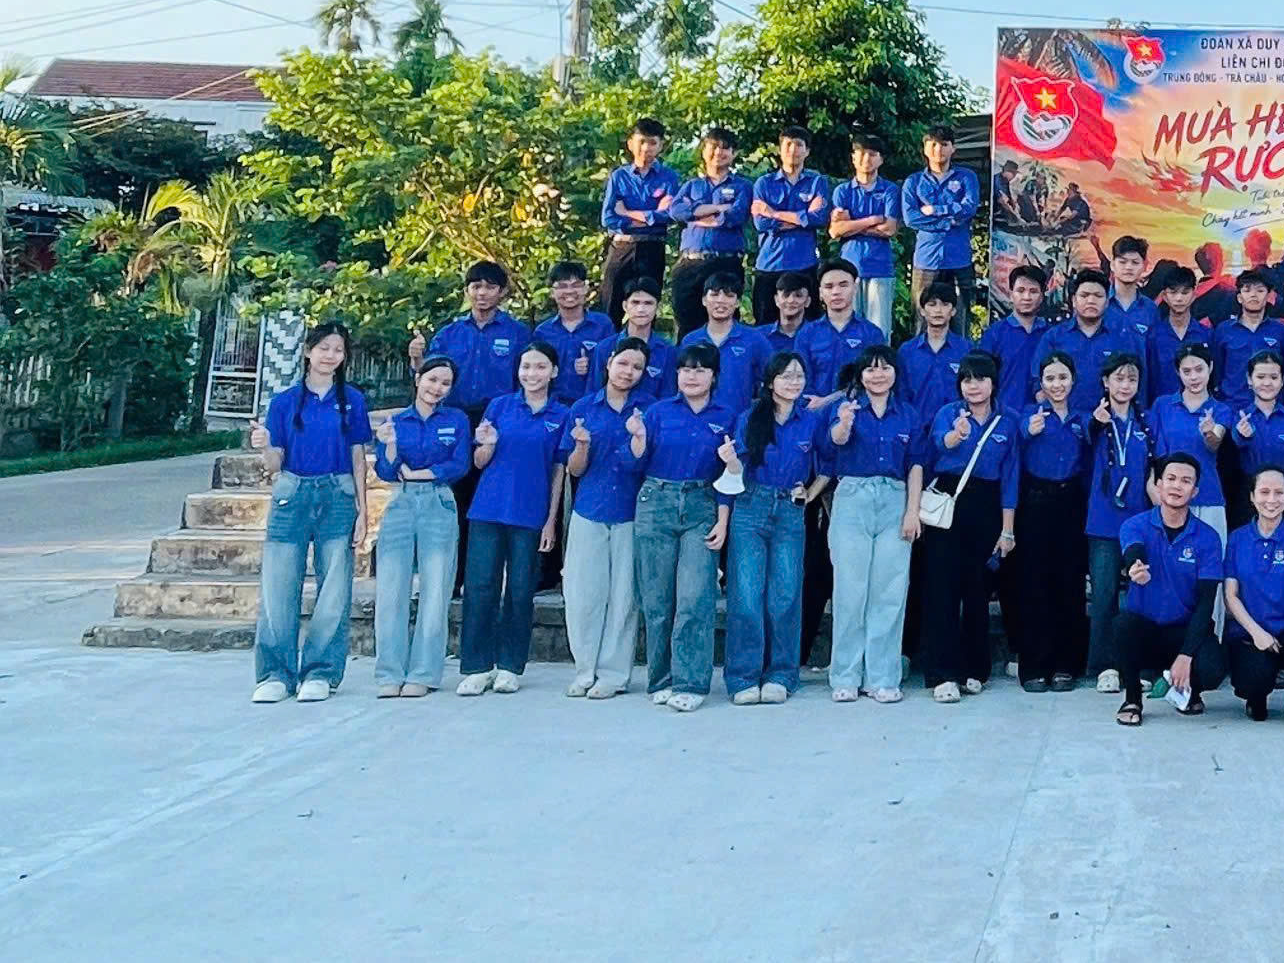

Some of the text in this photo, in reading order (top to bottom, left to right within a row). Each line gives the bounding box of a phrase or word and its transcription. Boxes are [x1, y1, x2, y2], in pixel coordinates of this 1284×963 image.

[1257, 37, 1280, 50] DUY
[1221, 53, 1247, 69] LIÊN
[1251, 56, 1270, 69] CHI
